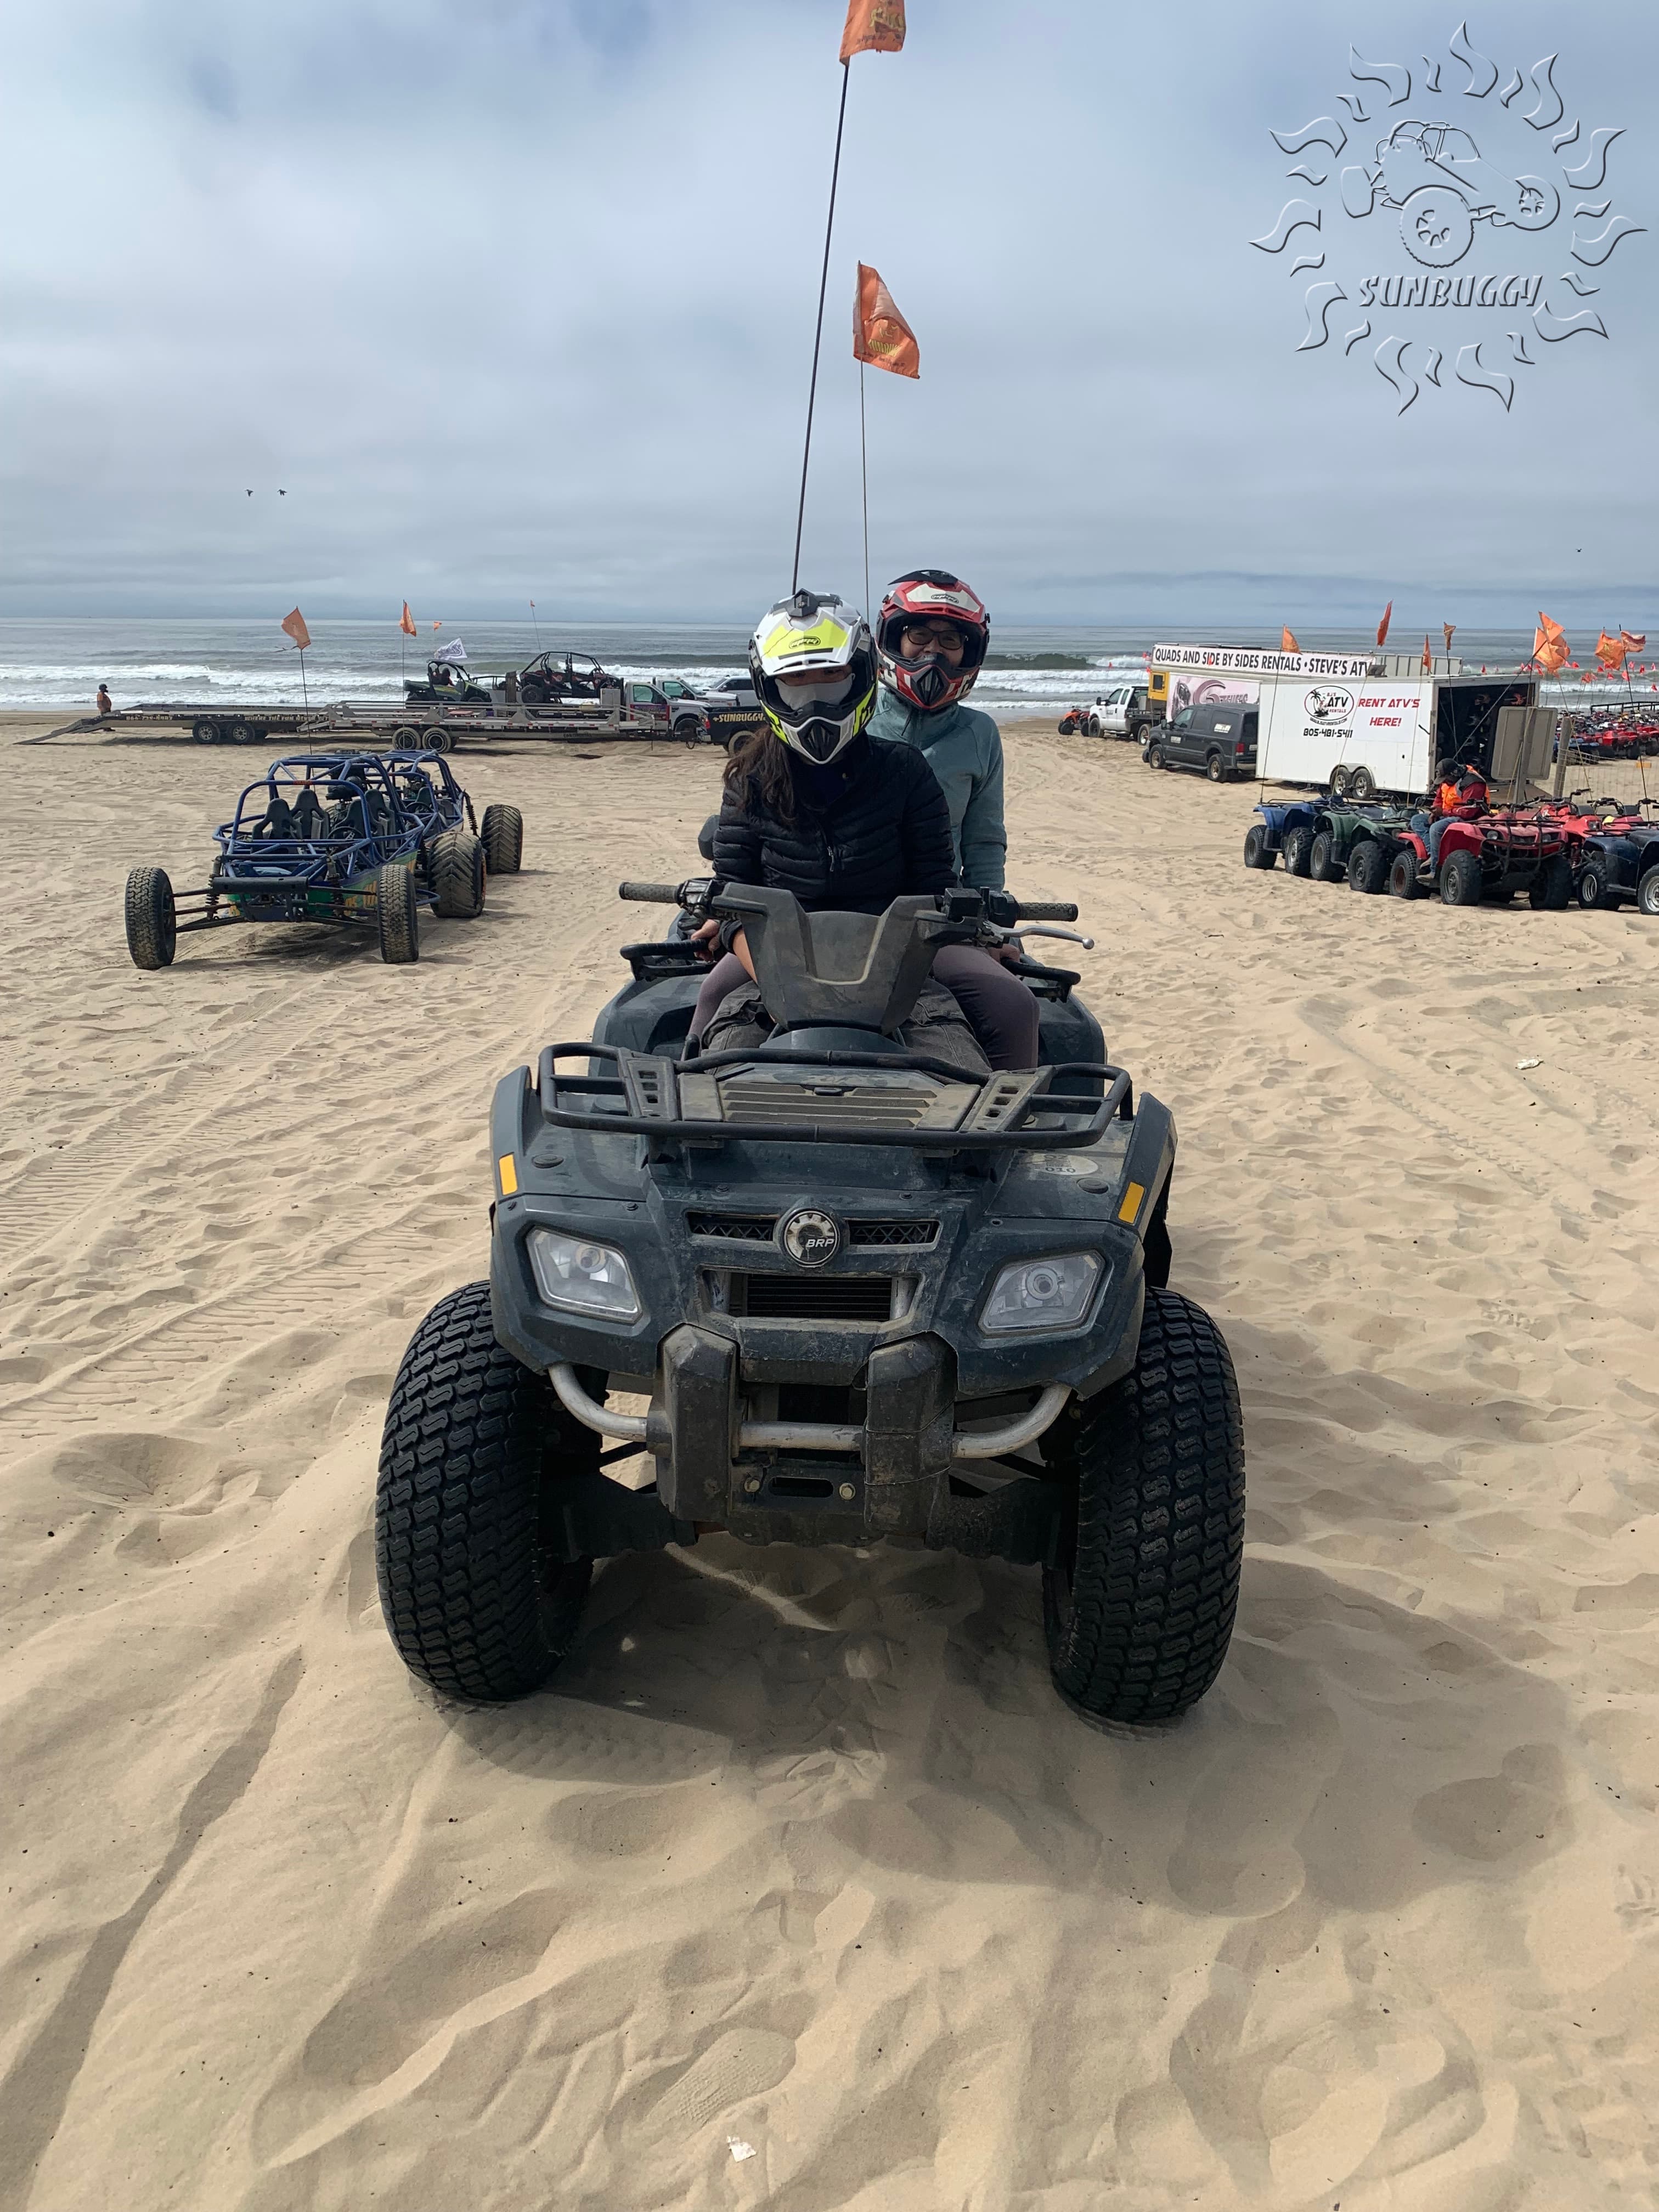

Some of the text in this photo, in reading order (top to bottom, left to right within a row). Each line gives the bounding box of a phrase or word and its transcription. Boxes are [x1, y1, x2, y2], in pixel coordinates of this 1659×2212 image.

[1155, 648, 1181, 662] QUADS
[1182, 650, 1200, 664] AND
[1202, 652, 1220, 666] SIDE
[1222, 653, 1233, 667] BY
[1234, 654, 1259, 669] SIDES
[1261, 655, 1301, 672] RENTALS
[1308, 658, 1348, 675] STEVE'S
[1327, 697, 1348, 707] ATV
[1358, 698, 1421, 708] RENT ATV'S
[1369, 717, 1402, 727] HERE!
[1304, 728, 1353, 738] 805-481-5411
[806, 1239, 834, 1248] BRP
